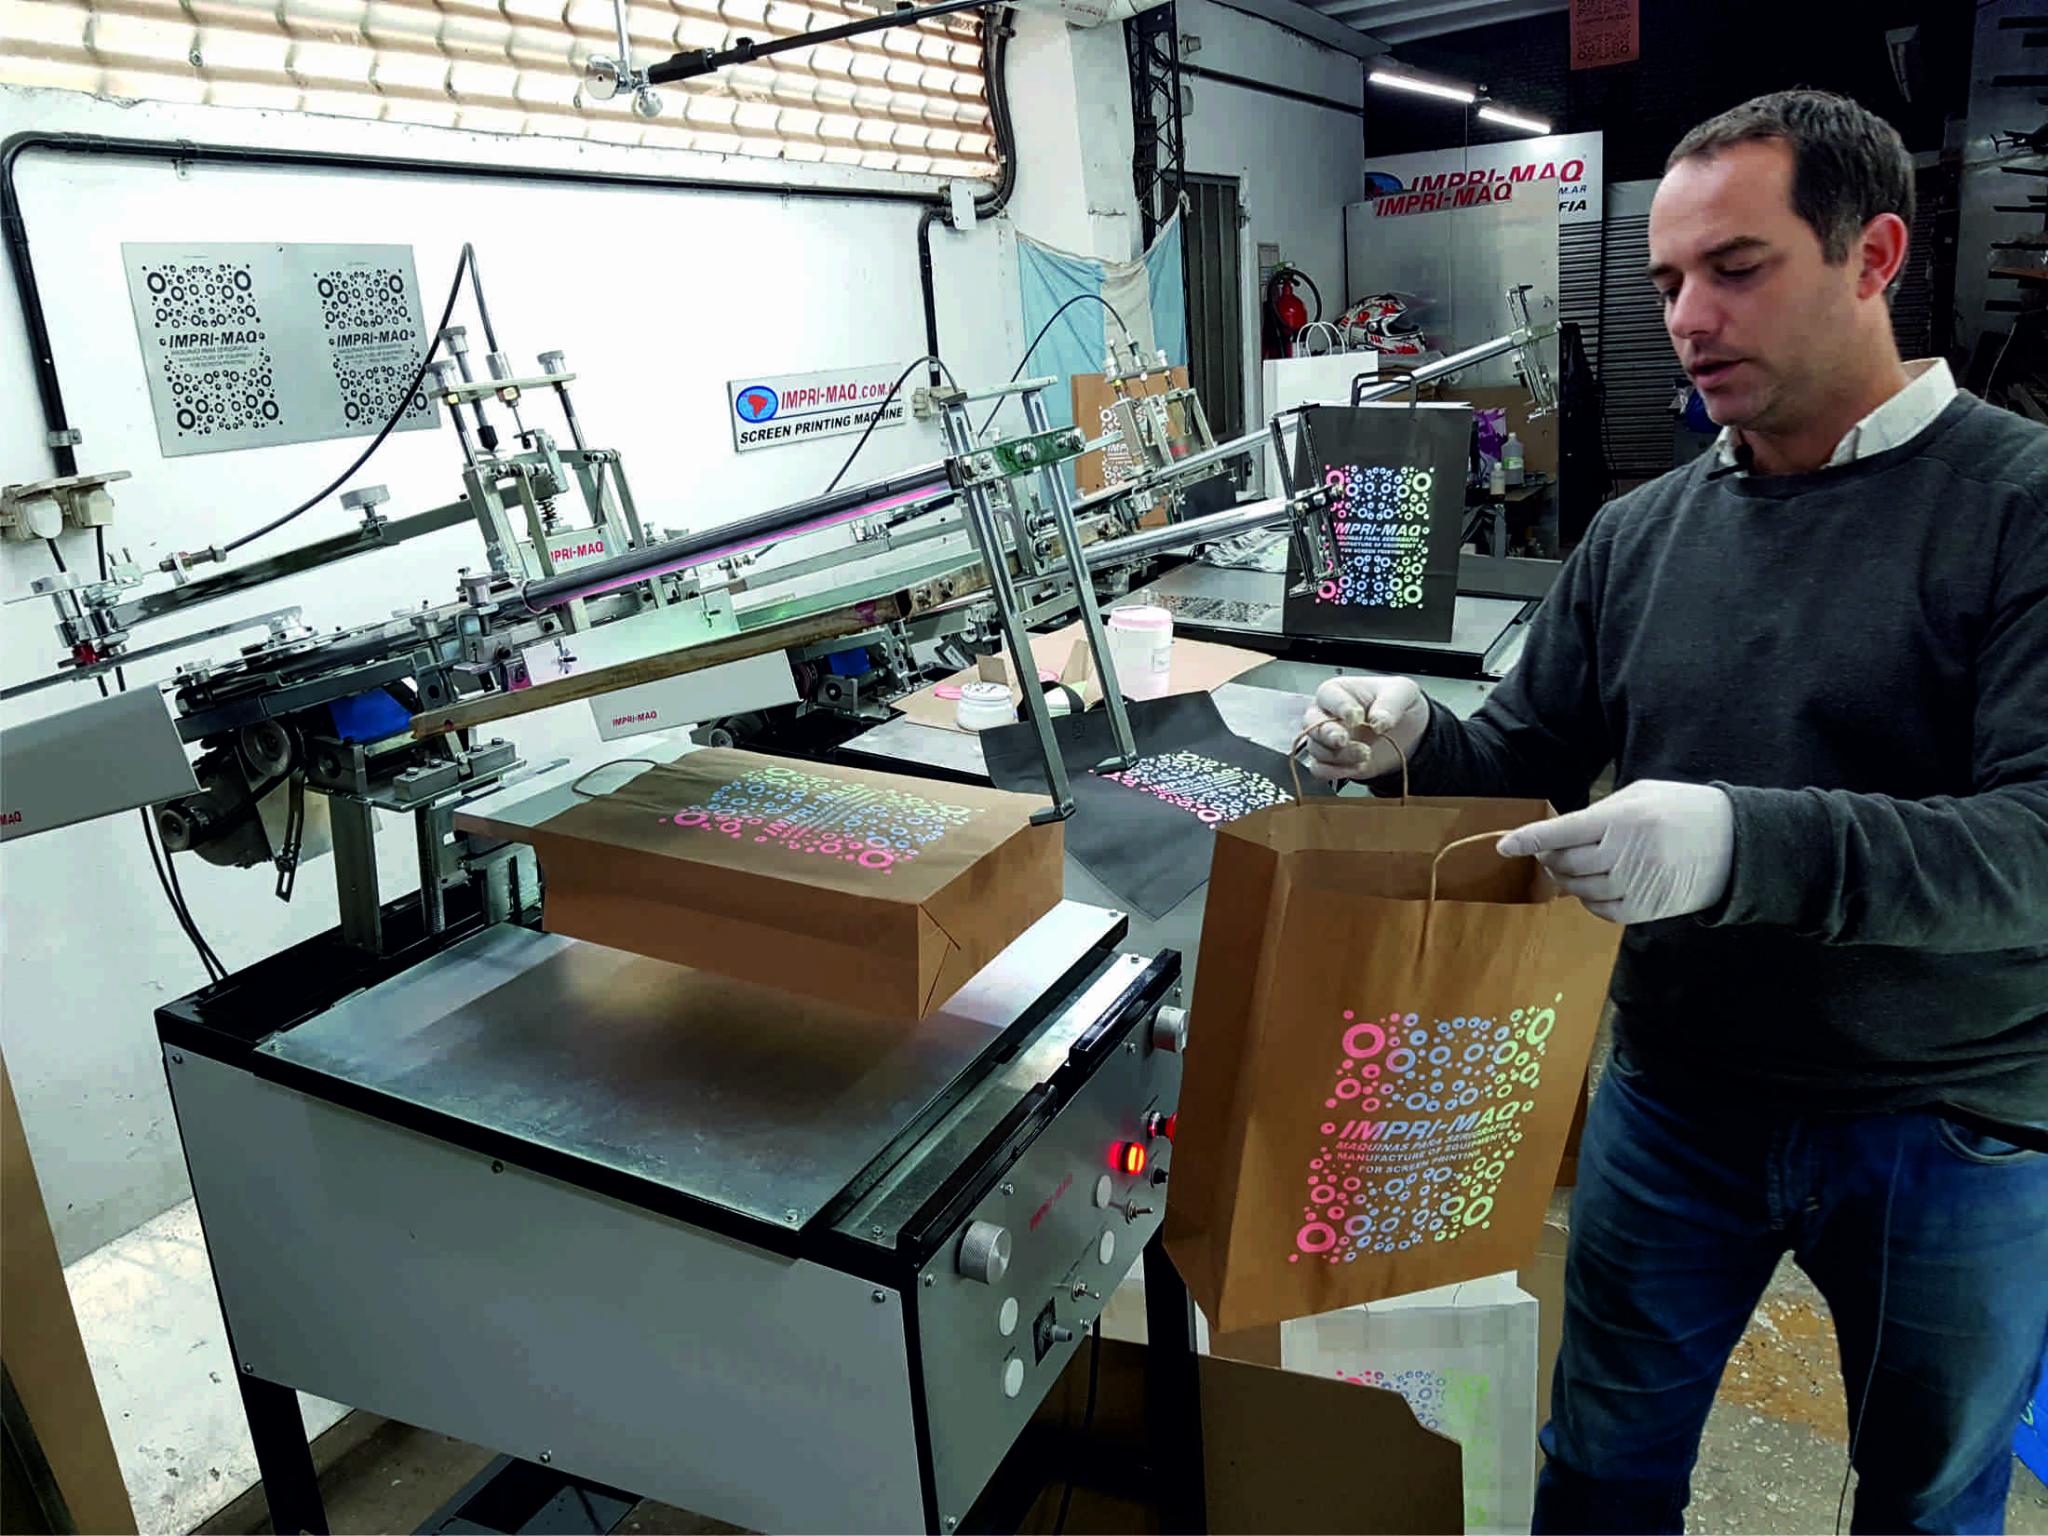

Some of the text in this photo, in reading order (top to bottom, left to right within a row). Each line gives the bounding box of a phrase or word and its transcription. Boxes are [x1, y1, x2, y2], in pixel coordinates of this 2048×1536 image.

[1376, 183, 1513, 216] IMPRI-MAQ
[169, 330, 258, 349] IMPRI-MAQ
[337, 329, 409, 348] IMPRI-MAQ
[740, 425, 791, 444] SCREEN
[795, 414, 851, 434] PRINTING
[550, 541, 605, 563] PRI-MAQ
[1338, 1100, 1521, 1142] IMPRI-MAQ
[1336, 1151, 1425, 1163] MANUFACTURE
[1445, 1132, 1505, 1152] EQUIPMENT
[1358, 1165, 1383, 1174] FOR
